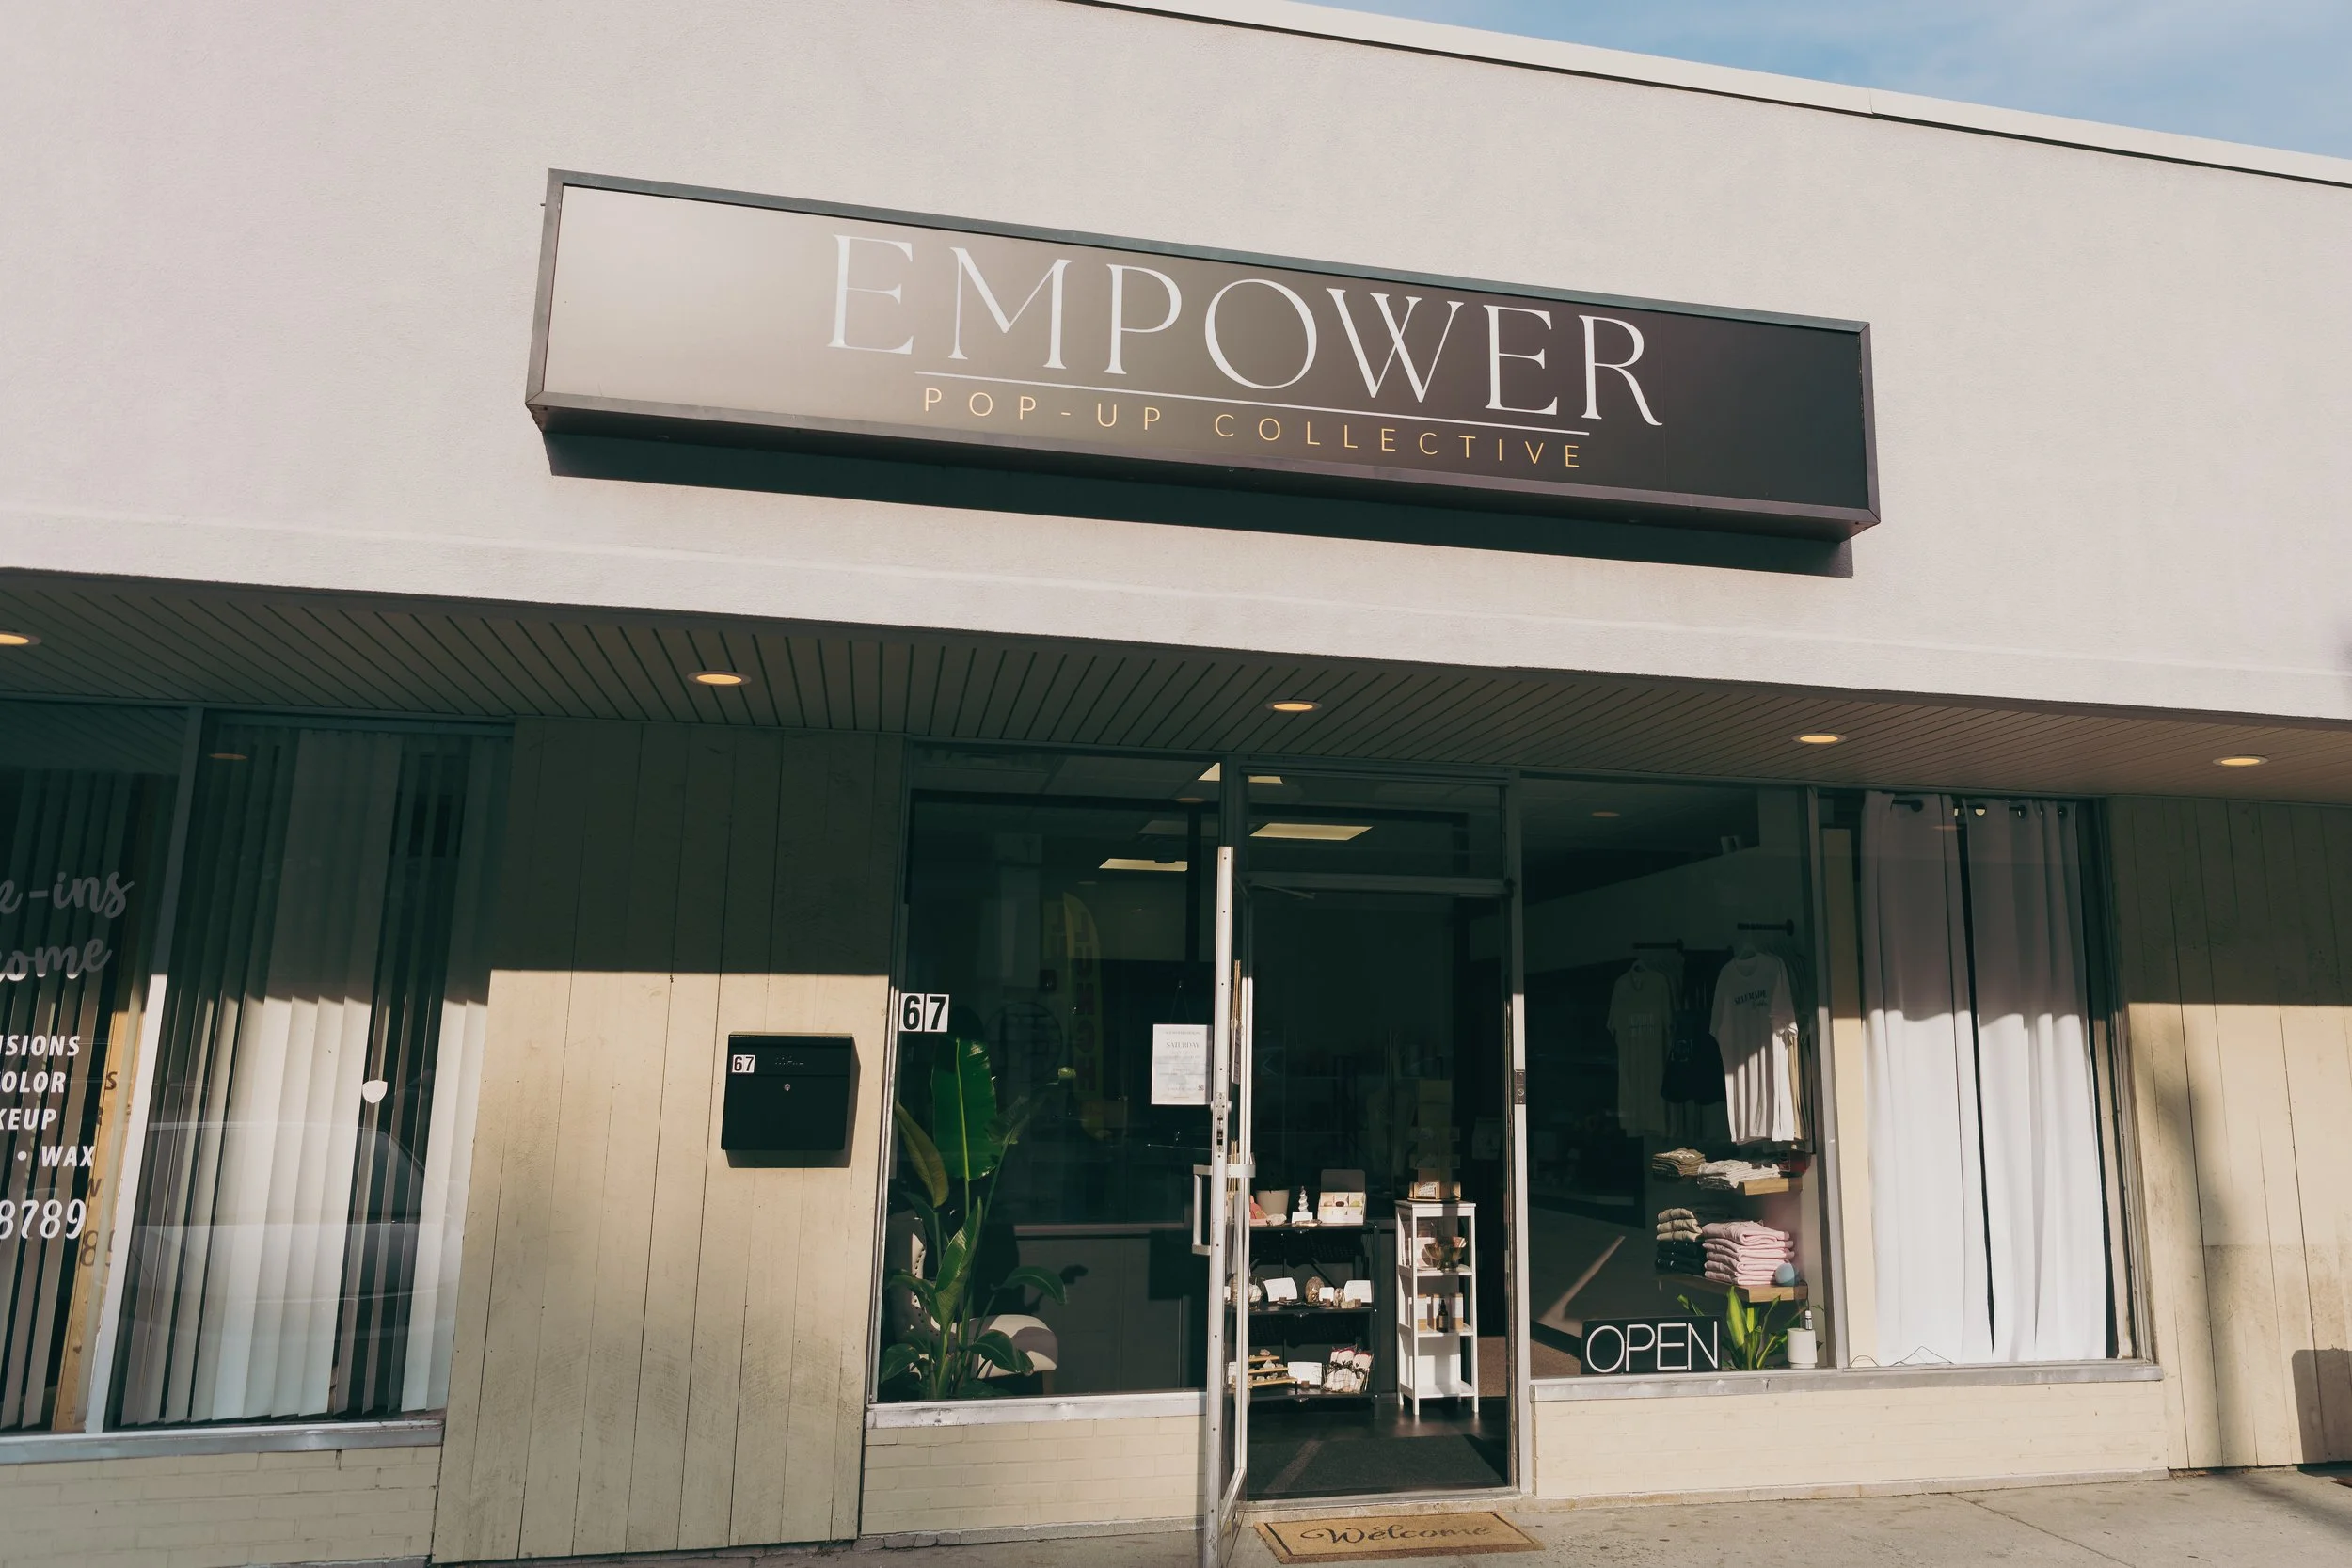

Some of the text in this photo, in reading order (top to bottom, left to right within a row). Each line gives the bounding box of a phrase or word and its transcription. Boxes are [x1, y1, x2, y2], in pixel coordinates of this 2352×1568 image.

[827, 234, 1662, 426] EMPOWER
[925, 387, 1581, 467] POP-UP COLLECTIVE
[0, 938, 113, 982] ome
[902, 995, 946, 1030] 67
[734, 1056, 755, 1071] 67
[41, 1145, 95, 1166] WAX
[0, 1198, 87, 1240] 8789
[1586, 1321, 1719, 1373] OPEN
[1300, 1524, 1494, 1544] Welcome
